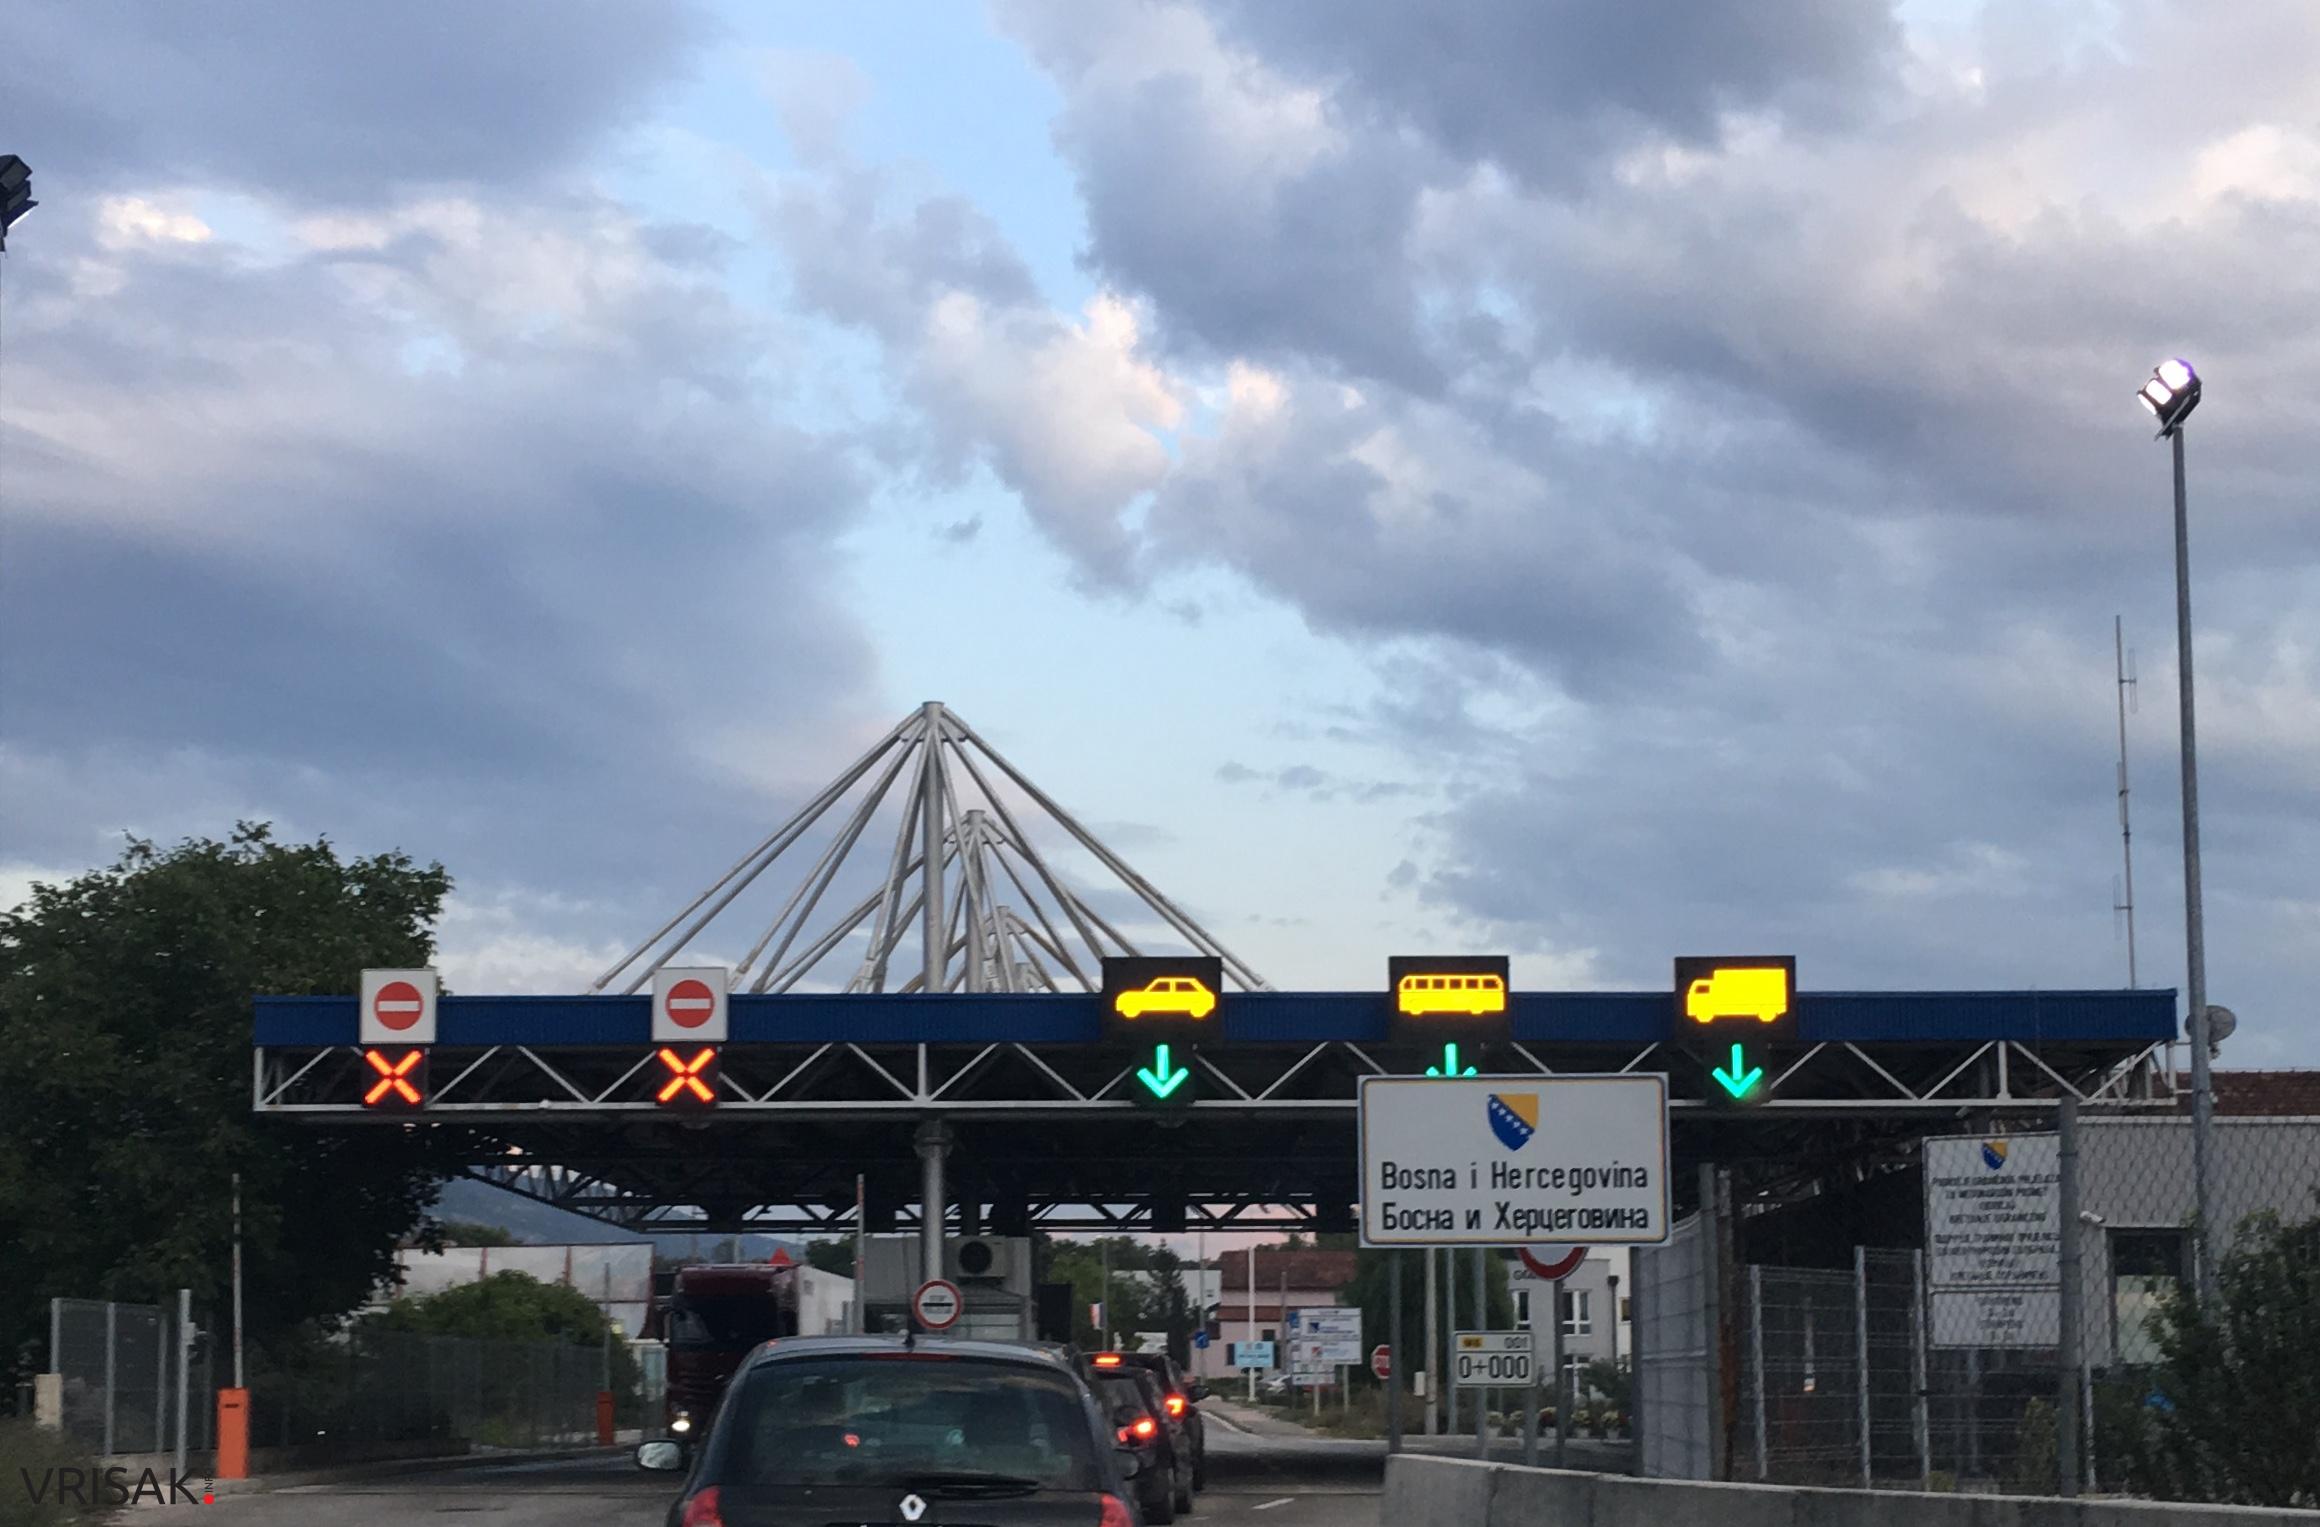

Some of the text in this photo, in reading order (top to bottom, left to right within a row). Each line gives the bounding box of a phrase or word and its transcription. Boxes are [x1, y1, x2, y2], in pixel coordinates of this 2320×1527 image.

[1381, 1160, 1648, 1197] Bosna i Hercegovina
[1381, 1201, 1649, 1237] Босна и Херцеговина
[1458, 1354, 1530, 1379] 0+000
